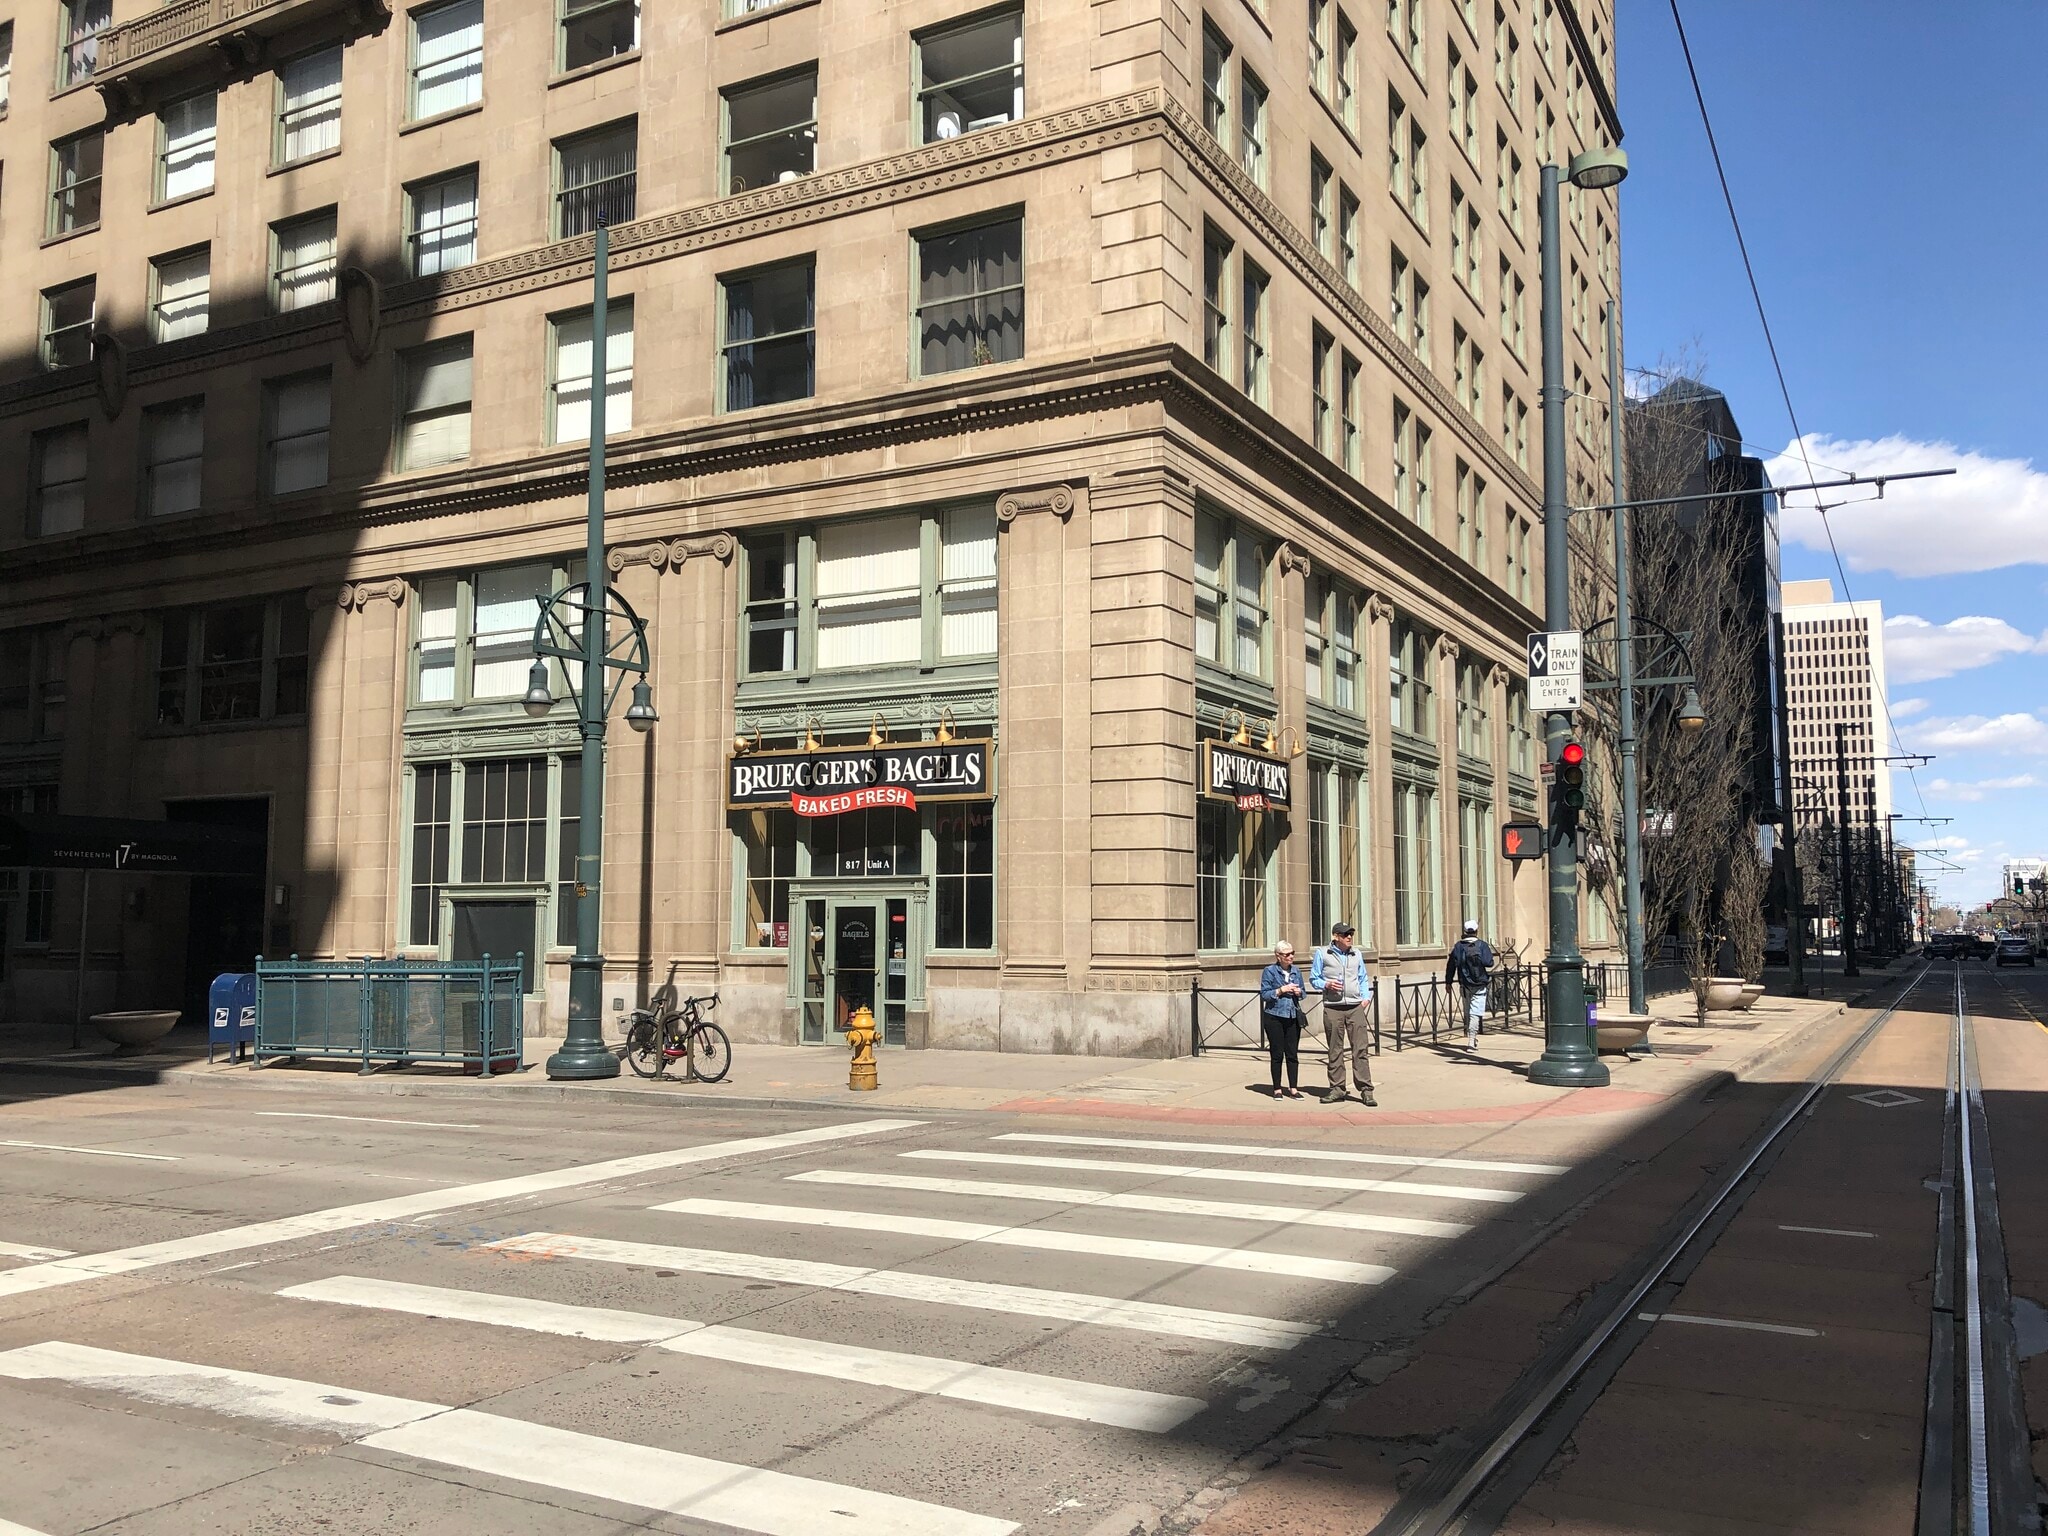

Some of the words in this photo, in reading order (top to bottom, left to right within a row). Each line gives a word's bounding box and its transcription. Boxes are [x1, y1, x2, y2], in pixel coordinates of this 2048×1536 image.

[1550, 648, 1578, 659] TRAIN
[1551, 661, 1576, 671] ONLY
[1539, 679, 1551, 687] DO
[1554, 678, 1570, 687] NOT
[1542, 688, 1568, 697] ENTER
[733, 757, 877, 797] BRUEGGER'S
[885, 752, 982, 786] BAGELS
[1212, 751, 1286, 799] BRUEGGER'S
[797, 796, 852, 815] BAKED
[856, 788, 908, 808] FRESH
[53, 850, 112, 859] SEVENTEENTH
[845, 860, 861, 870] 817
[867, 860, 882, 869] Unit
[883, 860, 890, 869] A
[842, 931, 870, 939] BAGELS
